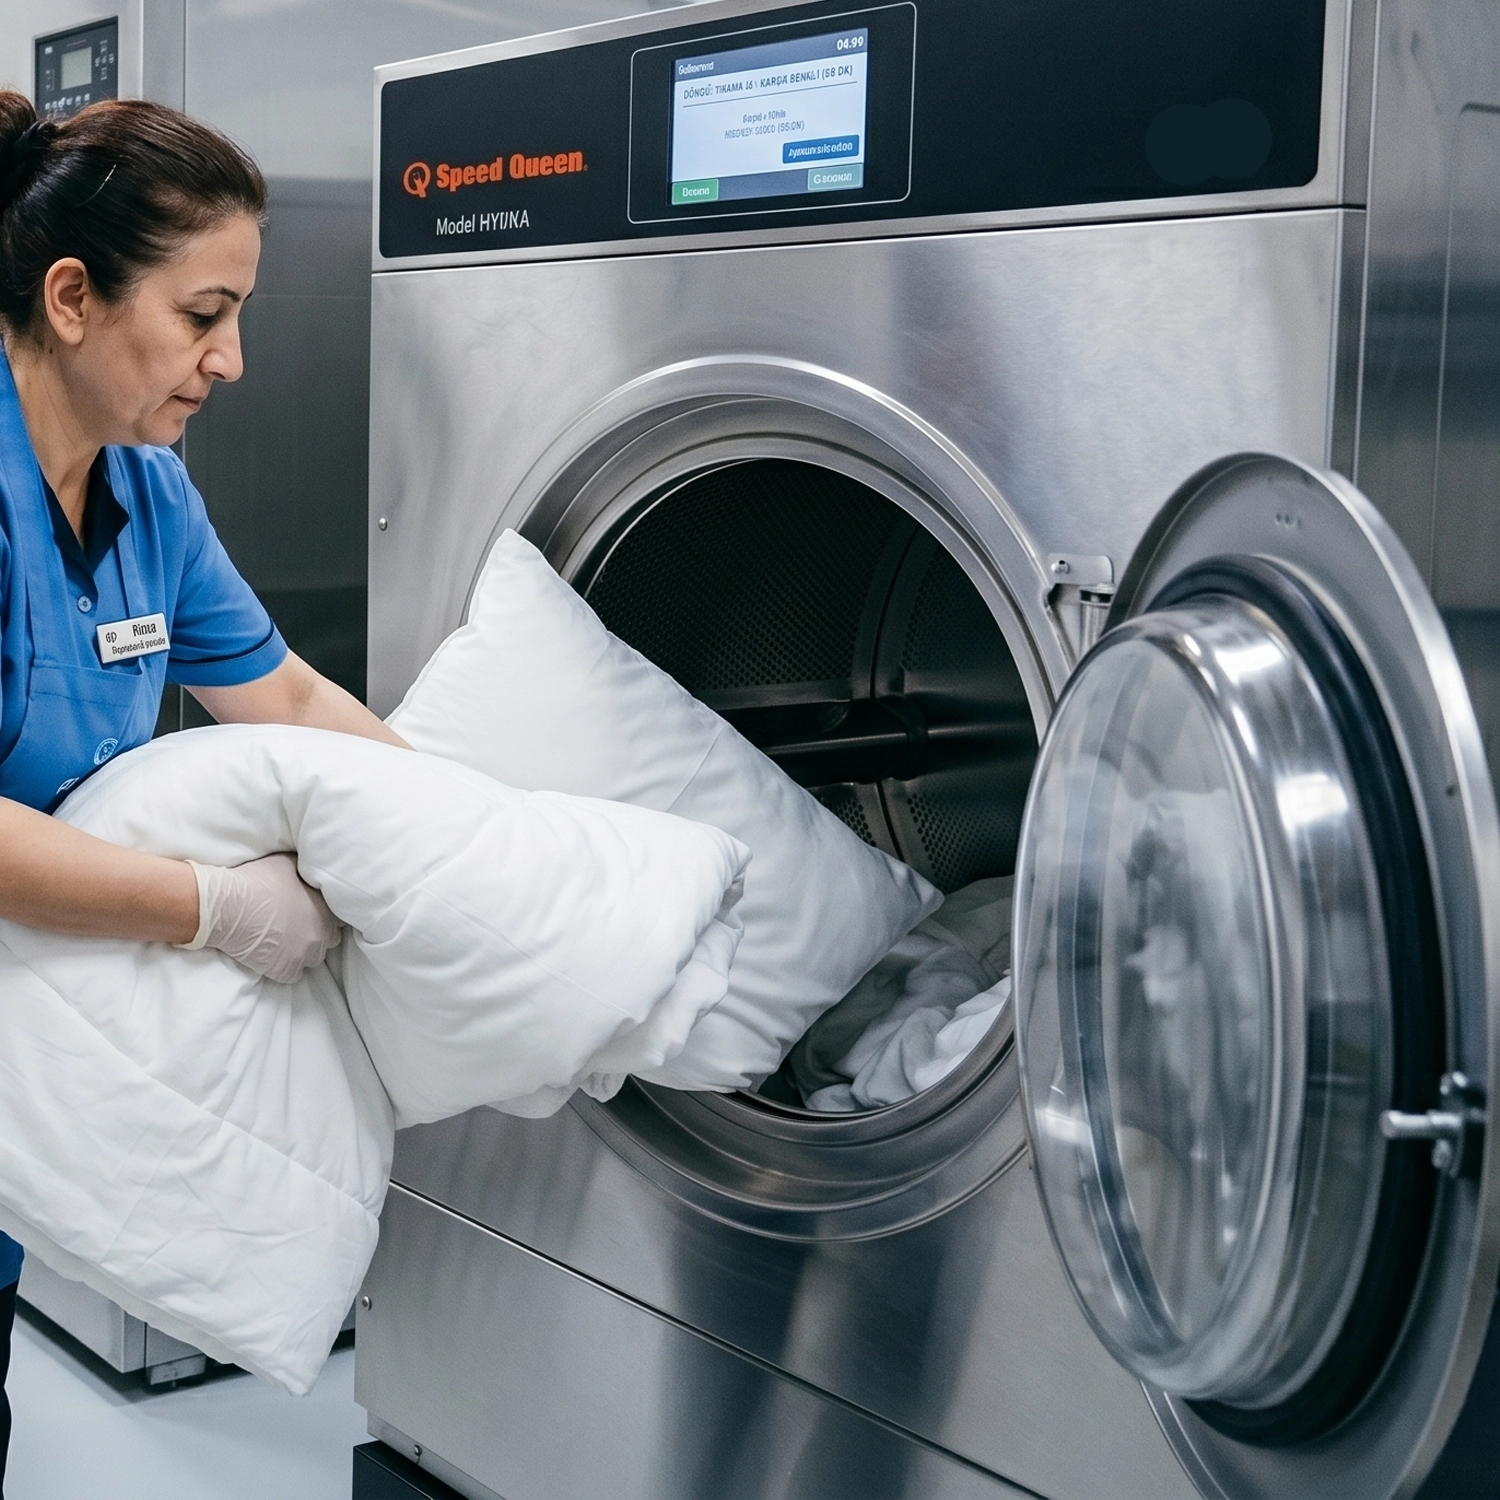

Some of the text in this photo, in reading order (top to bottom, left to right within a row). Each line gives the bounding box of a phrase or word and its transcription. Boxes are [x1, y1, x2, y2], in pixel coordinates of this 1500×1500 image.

[436, 157, 503, 193] Speed
[509, 151, 583, 180] Queen
[436, 213, 476, 236] Model
